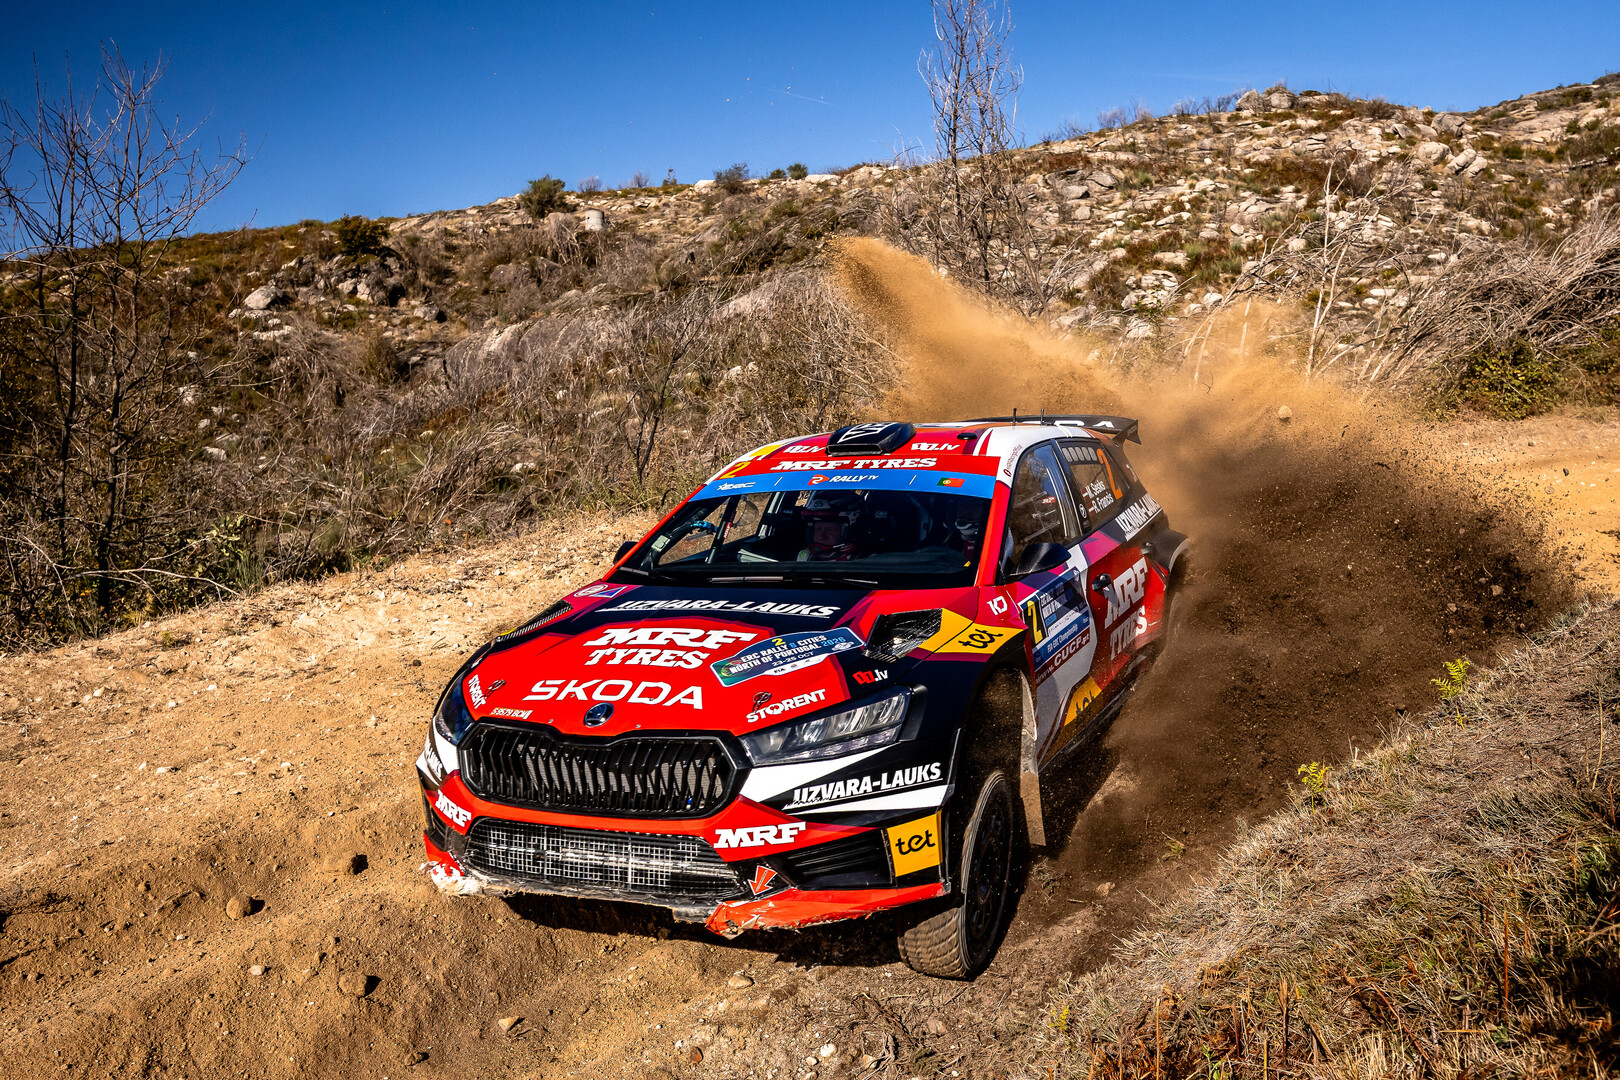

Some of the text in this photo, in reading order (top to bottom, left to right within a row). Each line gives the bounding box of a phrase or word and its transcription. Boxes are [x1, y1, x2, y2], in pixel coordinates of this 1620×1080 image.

[719, 461, 751, 480] 2
[770, 458, 937, 471] MRF TYRES
[1097, 448, 1123, 500] 2
[1105, 557, 1149, 629] MRF
[613, 599, 841, 617] UZVARA-LAUKS
[1027, 600, 1044, 645] 2
[1109, 605, 1148, 662] TYRES
[583, 627, 759, 650] MRF
[740, 652, 759, 663] ERC
[760, 644, 788, 657] RALLY
[797, 635, 828, 647] CITIES
[772, 637, 786, 647] 2
[957, 628, 1004, 650] tet
[584, 647, 711, 669] TYRES
[729, 659, 762, 675] NORTH
[762, 655, 774, 664] OF
[774, 643, 822, 661] PORTUGAL
[852, 669, 889, 685] 11.lv
[746, 689, 826, 723] STORENT
[788, 762, 942, 807] UZVARA-LAUKS
[435, 788, 472, 828] MRF
[713, 821, 807, 849] MRF
[895, 829, 936, 856] tet
